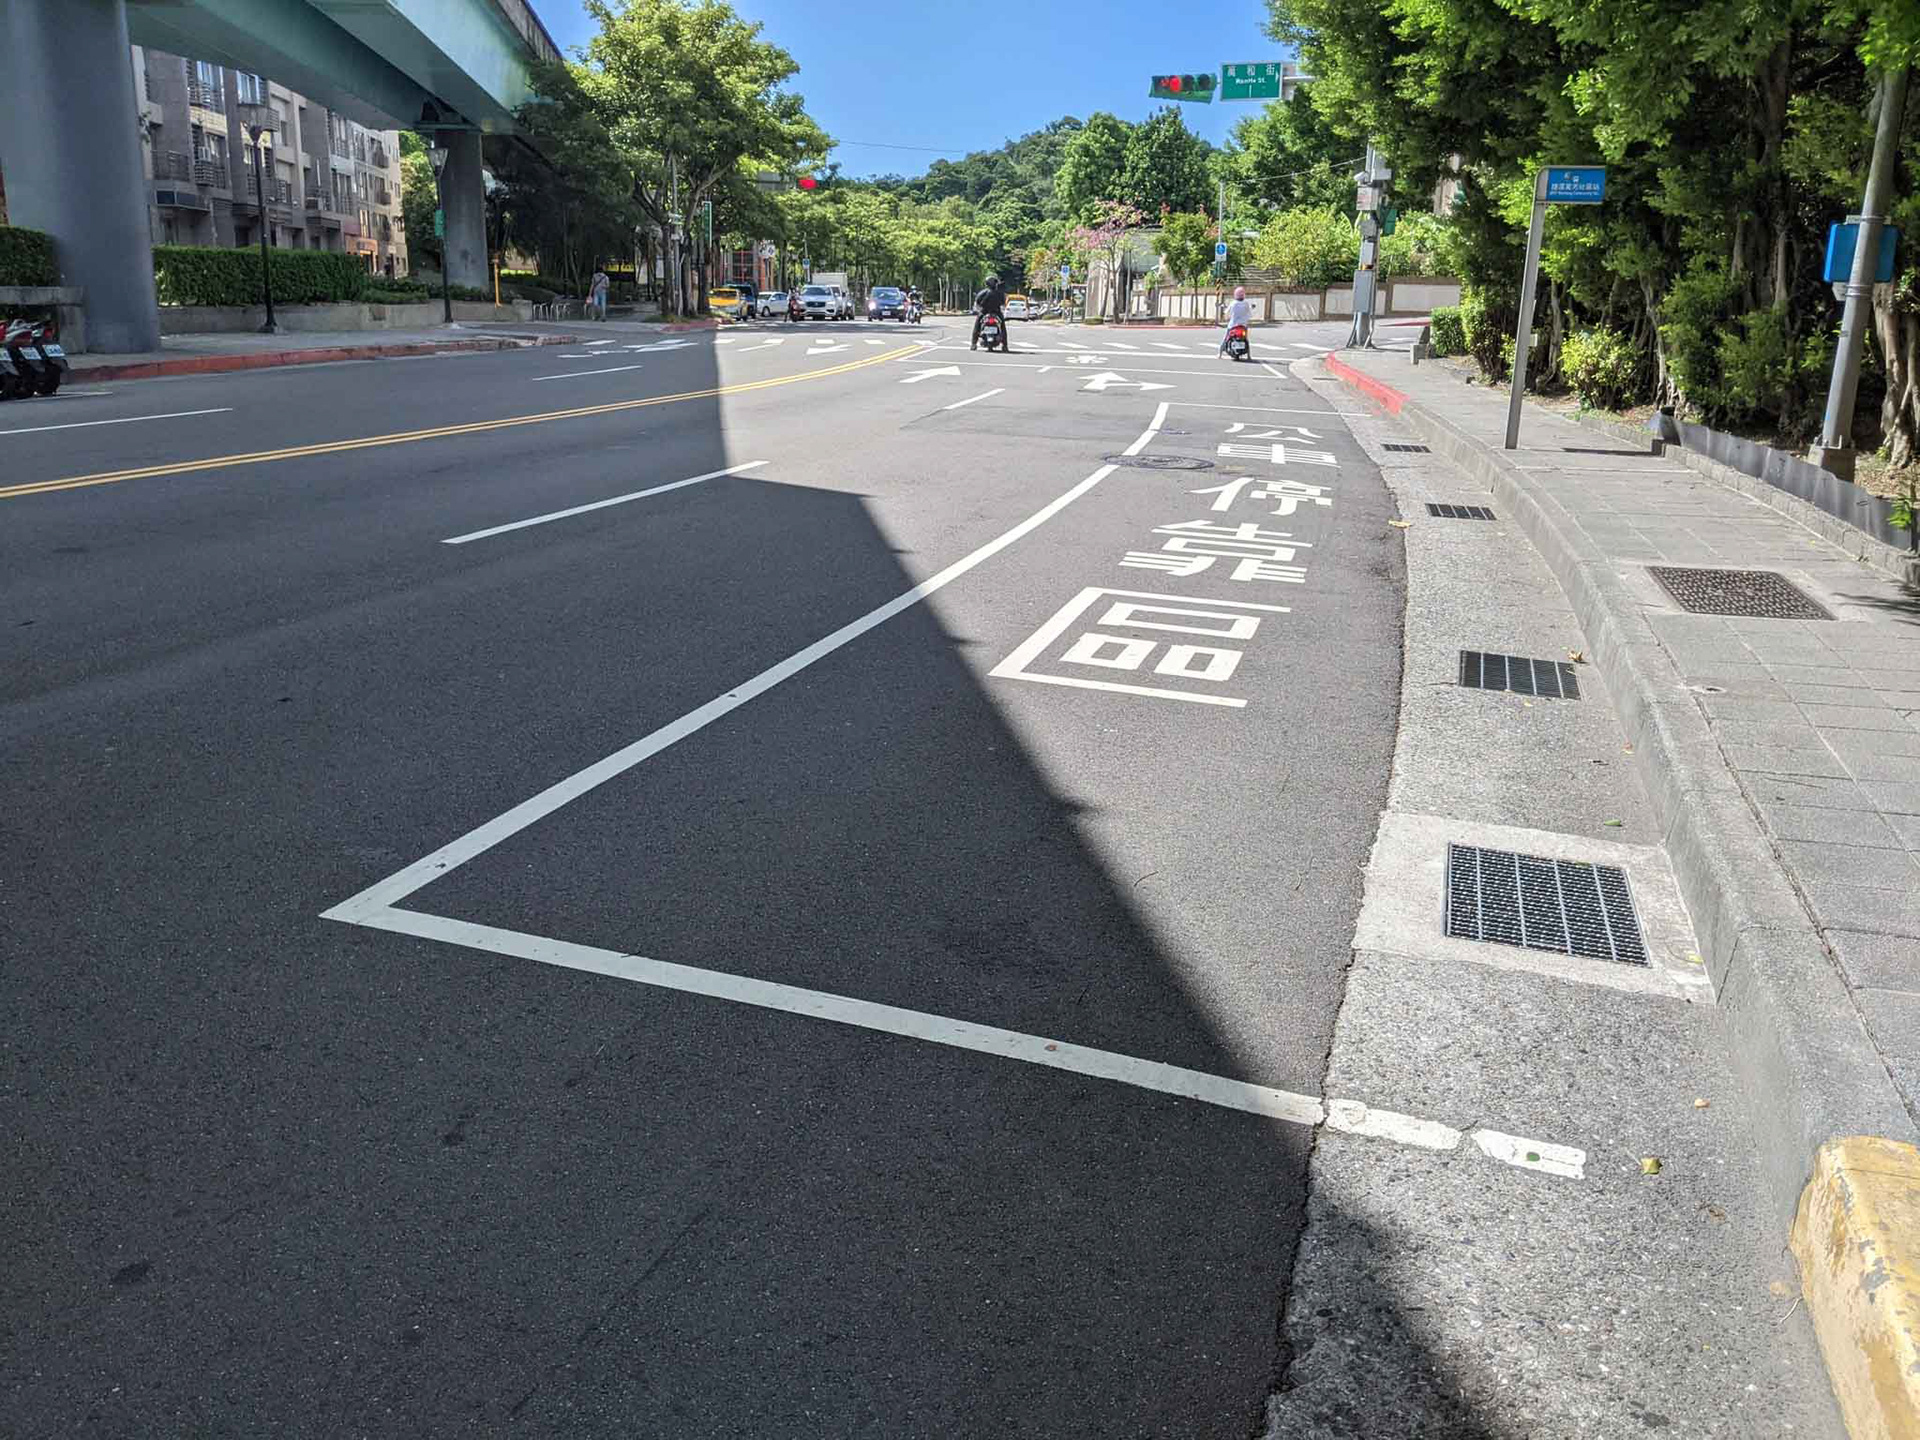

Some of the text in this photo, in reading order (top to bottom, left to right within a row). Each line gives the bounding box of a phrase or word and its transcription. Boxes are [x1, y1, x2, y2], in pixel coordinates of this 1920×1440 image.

[988, 423, 1341, 707] 公車停靠區
